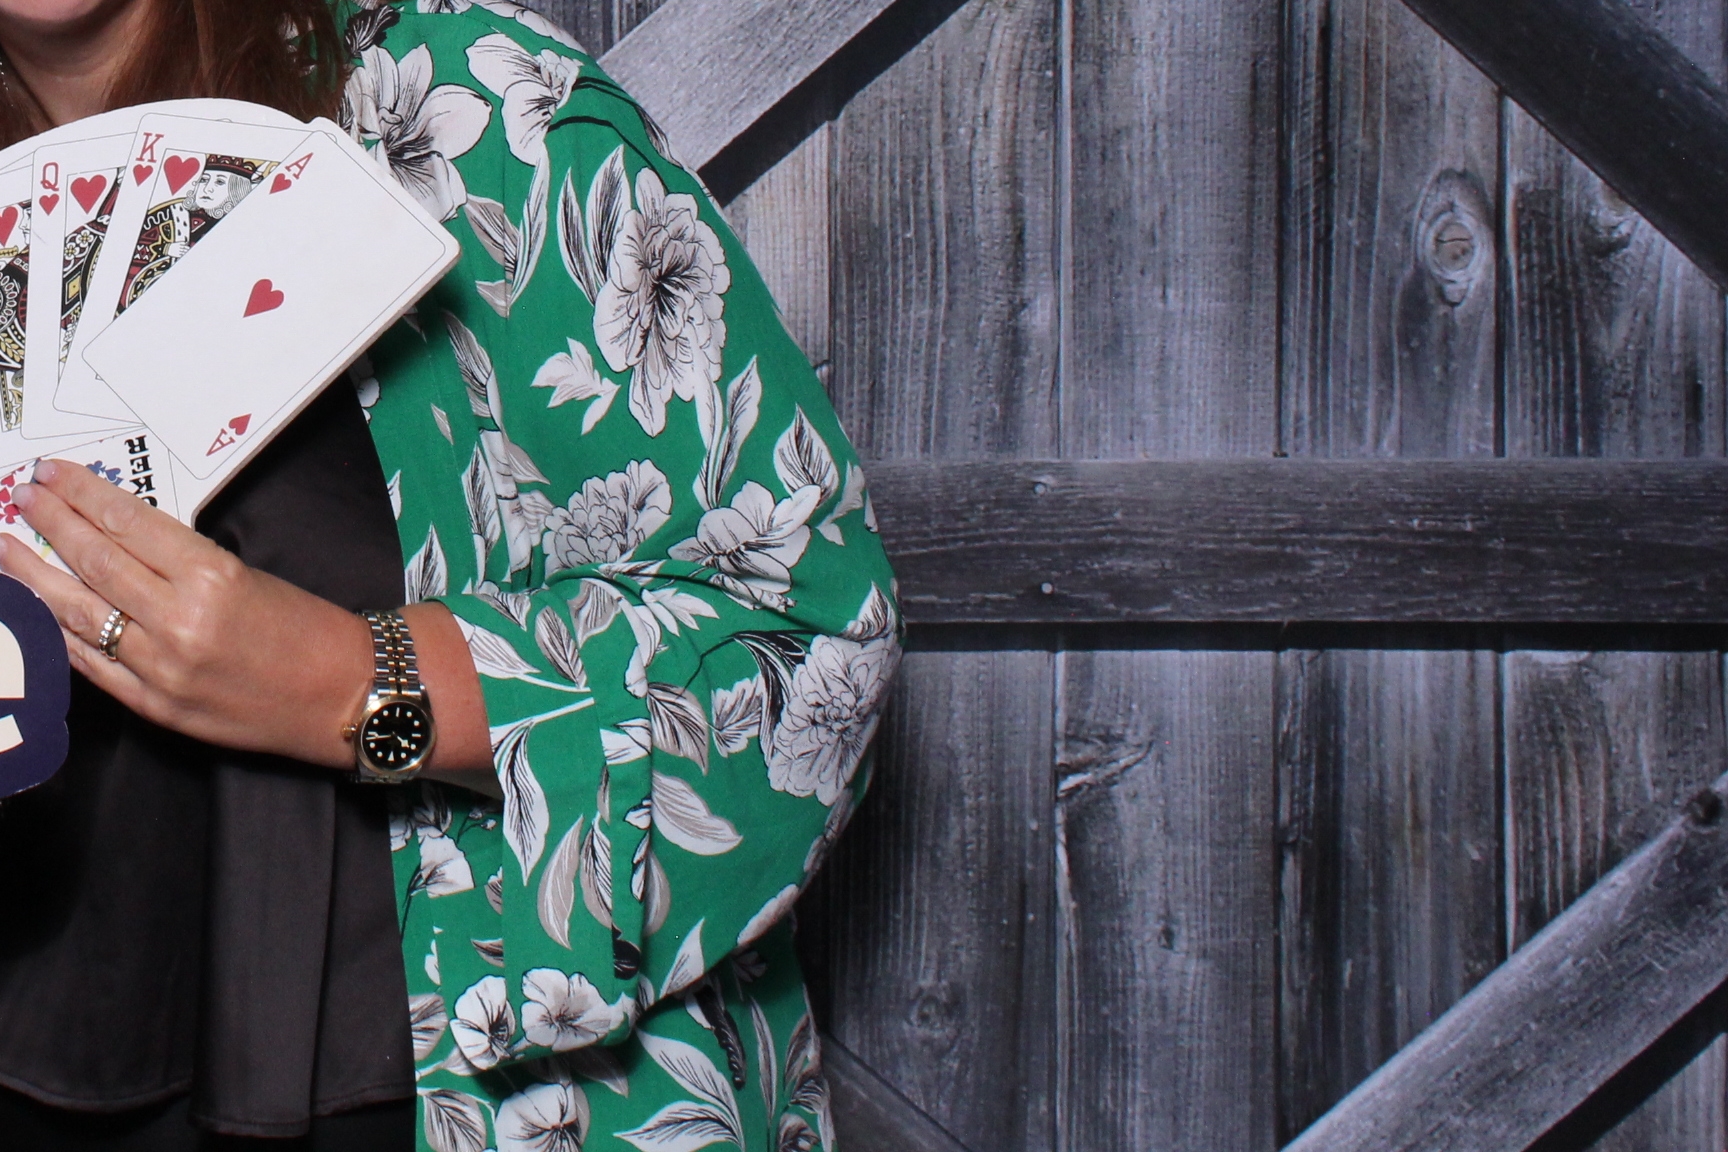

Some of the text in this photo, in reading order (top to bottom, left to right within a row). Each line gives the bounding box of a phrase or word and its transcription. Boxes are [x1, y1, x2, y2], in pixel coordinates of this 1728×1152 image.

[136, 132, 164, 163] K
[40, 162, 60, 192] Q
[285, 152, 314, 180] A
[206, 427, 236, 457] A
[124, 435, 158, 508] KER
